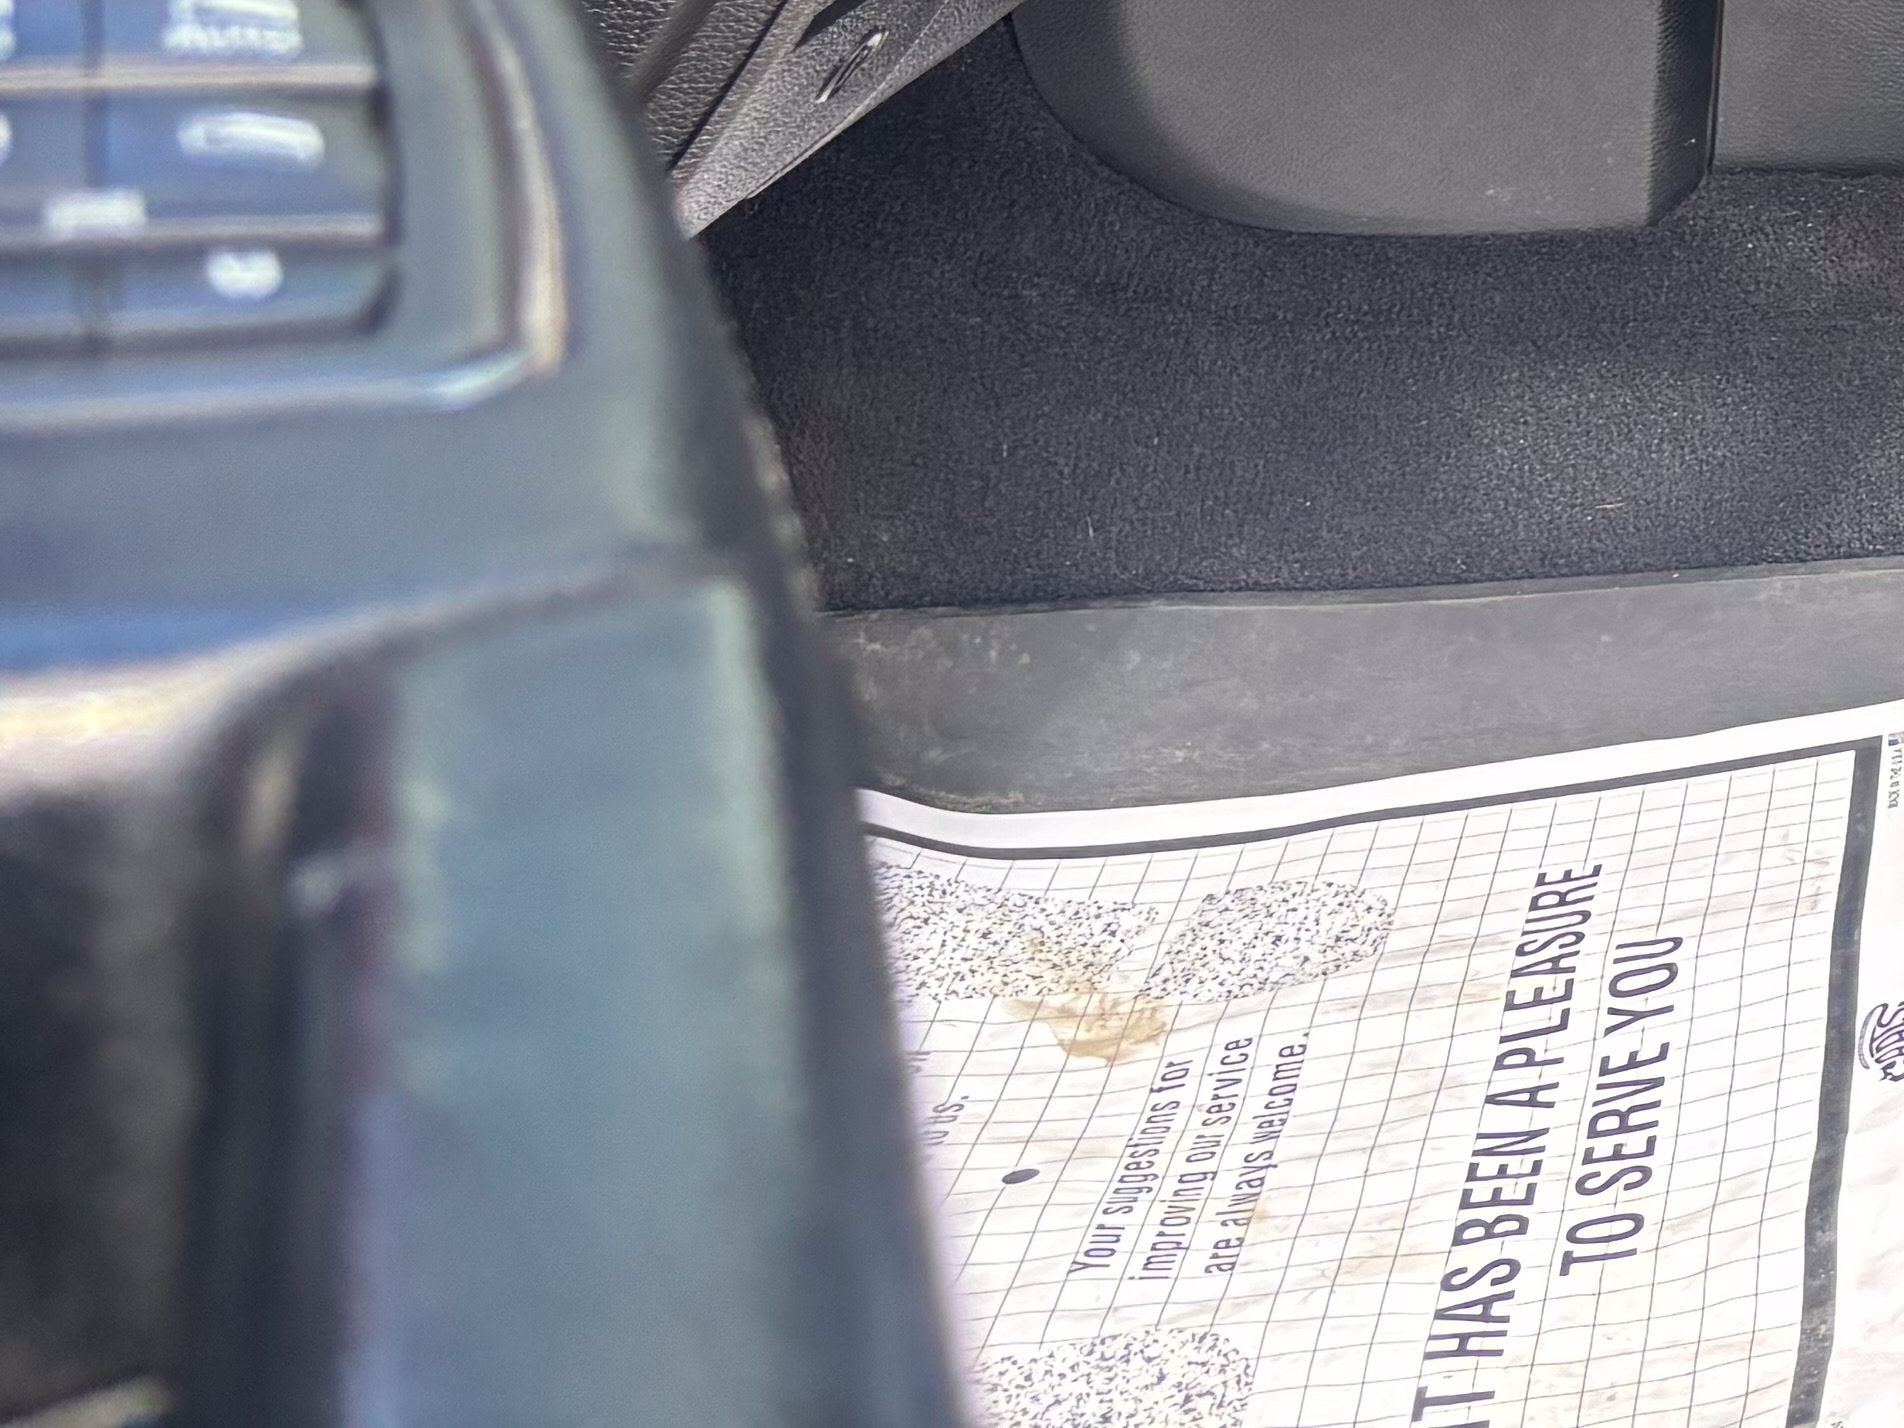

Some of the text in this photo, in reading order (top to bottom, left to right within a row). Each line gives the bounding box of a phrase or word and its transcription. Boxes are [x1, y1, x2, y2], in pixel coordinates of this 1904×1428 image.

[1492, 863, 1603, 1070] PLEASURE
[1066, 1058, 1194, 1275] Your suggestions for
[1129, 1037, 1254, 1281] improving our service
[1202, 1031, 1309, 1274] are always welcome.
[1451, 1127, 1551, 1246] BEEN
[1484, 1082, 1559, 1109] A
[1558, 936, 1684, 1277] TO SERVE YOU
[1423, 1258, 1523, 1360] HAS
